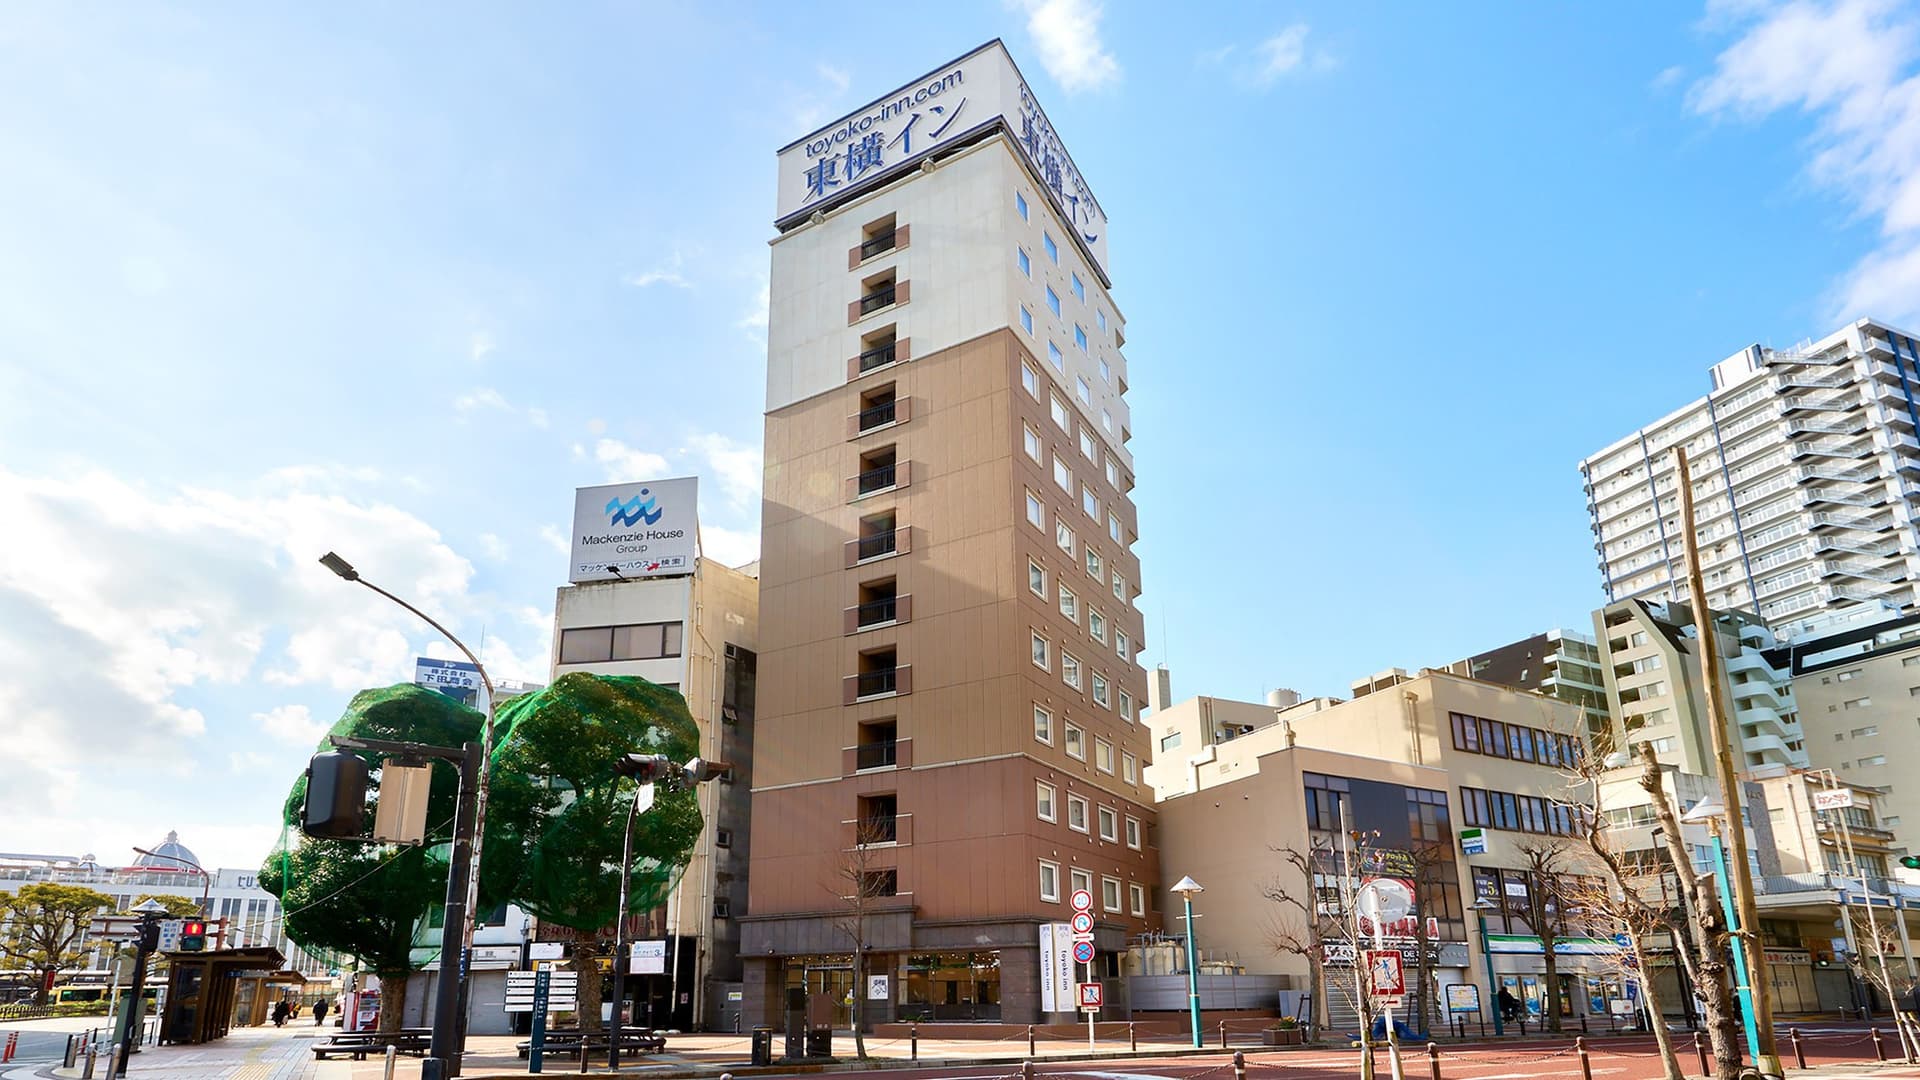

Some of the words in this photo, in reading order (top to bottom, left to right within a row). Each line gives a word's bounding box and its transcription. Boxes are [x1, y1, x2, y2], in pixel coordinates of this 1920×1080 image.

[805, 69, 963, 158] toyoko-inn.com
[802, 97, 967, 203] 東横イン
[581, 531, 644, 545] Mackenzie
[646, 529, 684, 541] House
[615, 544, 648, 554] Group
[1076, 896, 1088, 906] 40
[1380, 916, 1439, 938] YAMAA
[1061, 950, 1069, 977] toyoko
